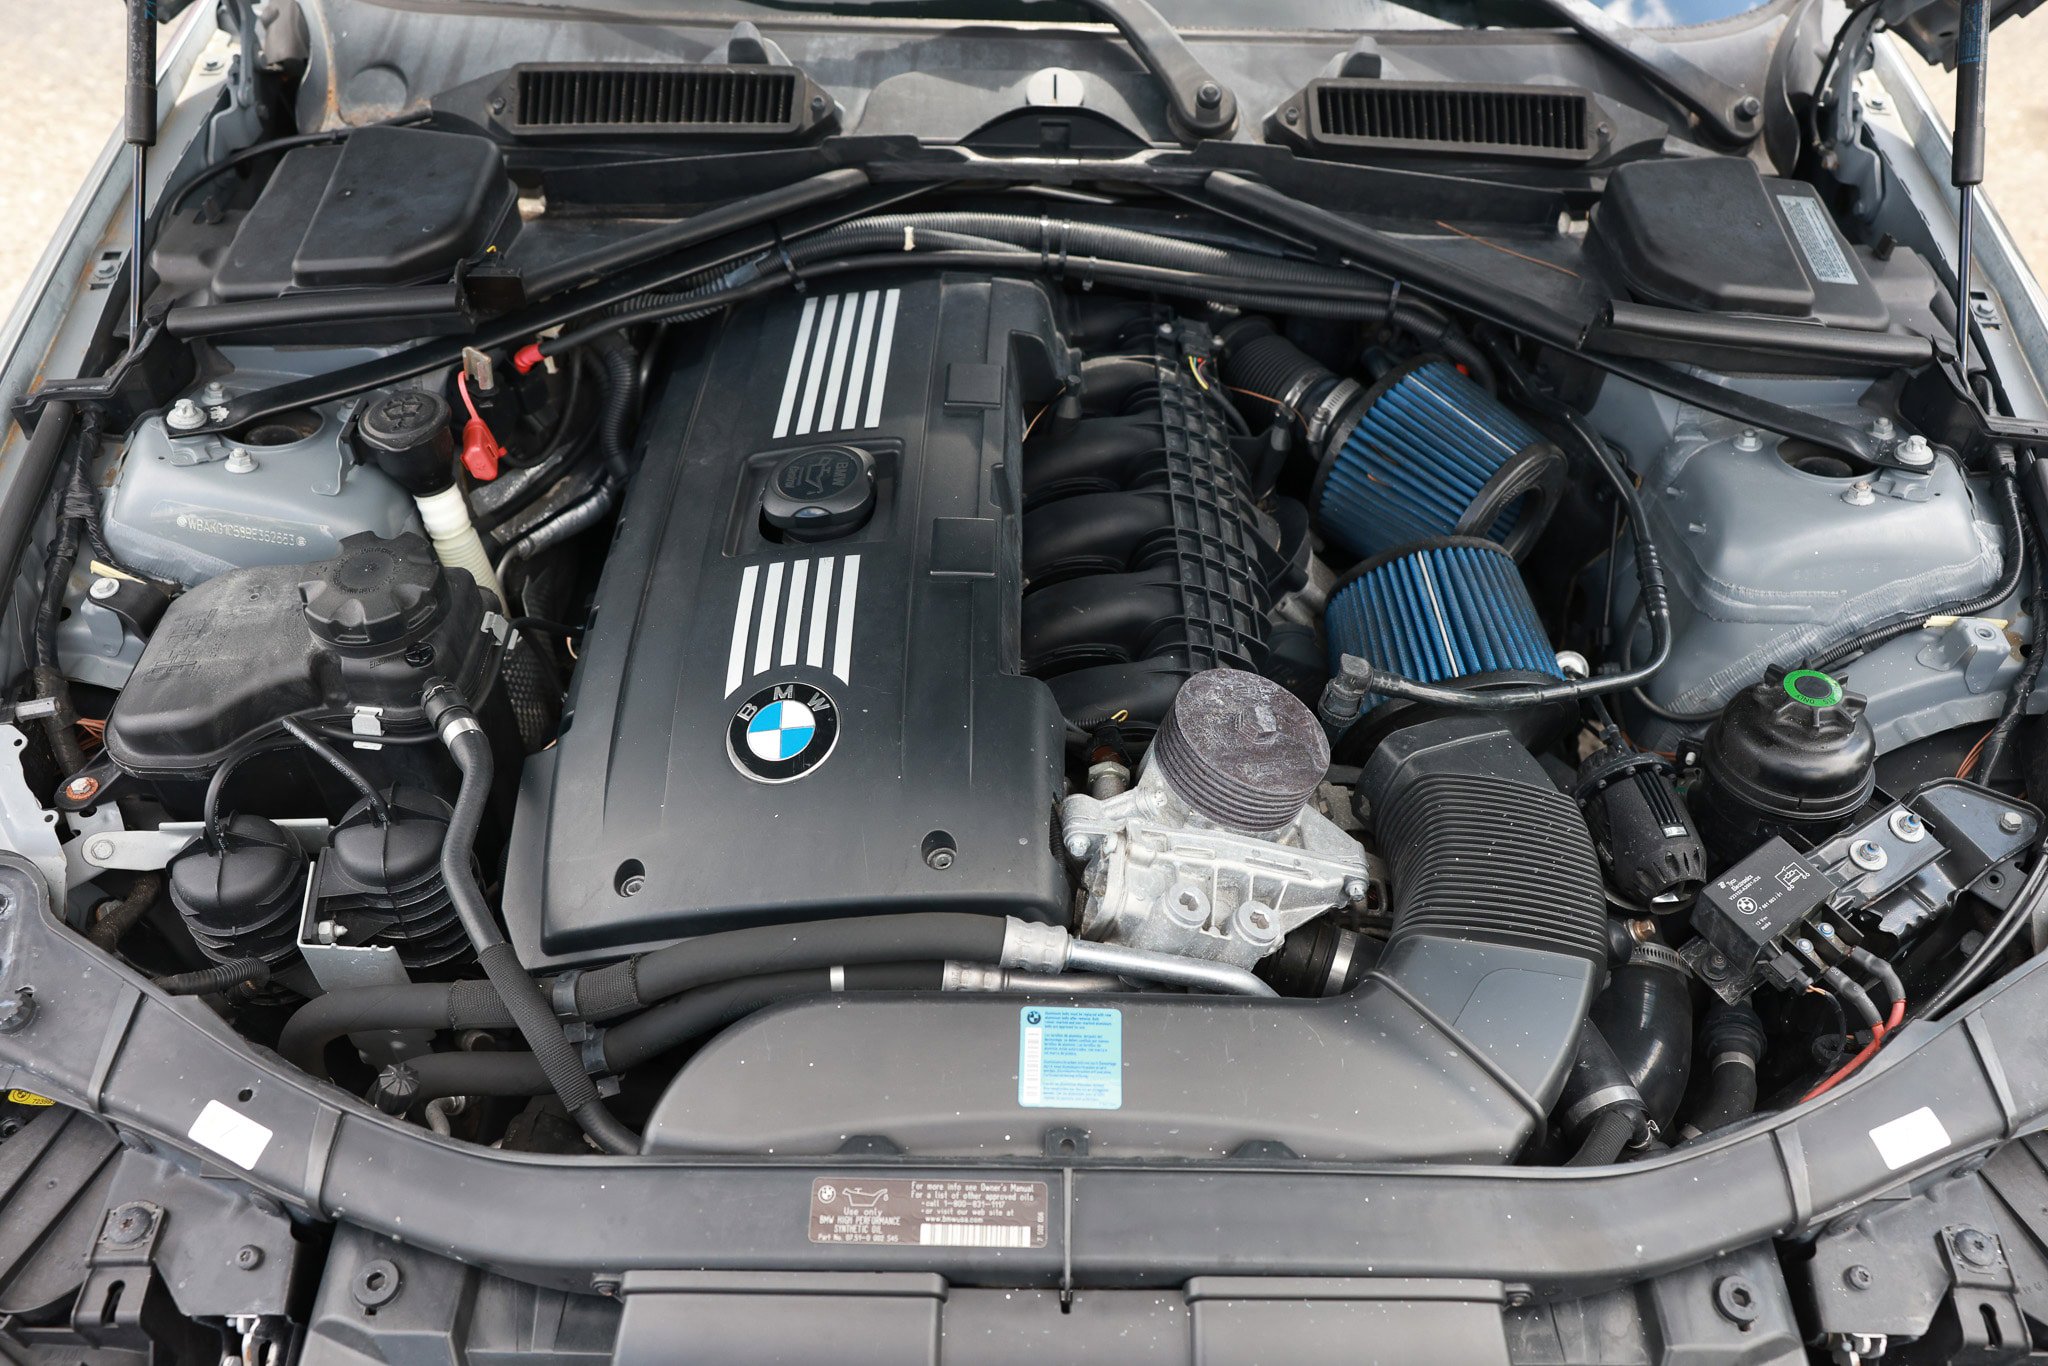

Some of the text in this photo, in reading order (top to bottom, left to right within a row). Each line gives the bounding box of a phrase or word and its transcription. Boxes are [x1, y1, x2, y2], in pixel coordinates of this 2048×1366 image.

[832, 461, 849, 486] BMW
[737, 685, 831, 721] BMW
[911, 1181, 923, 1190] For
[948, 1182, 961, 1191] info
[965, 1184, 977, 1192] see
[980, 1182, 1007, 1192] Owner's
[1010, 1184, 1034, 1192] Manual
[911, 1190, 923, 1198] For
[934, 1190, 947, 1199] list
[951, 1191, 959, 1199] of
[962, 1191, 981, 1200] other
[985, 1192, 1016, 1202] approved
[1020, 1192, 1034, 1202] oils
[944, 1200, 1005, 1208] 1-800-831-1117
[843, 1206, 883, 1217] Use only
[972, 1208, 986, 1216] web
[819, 1214, 900, 1226] BMW HIGH PERFORMANCE
[834, 1224, 882, 1234] SYNTHETIC OIL
